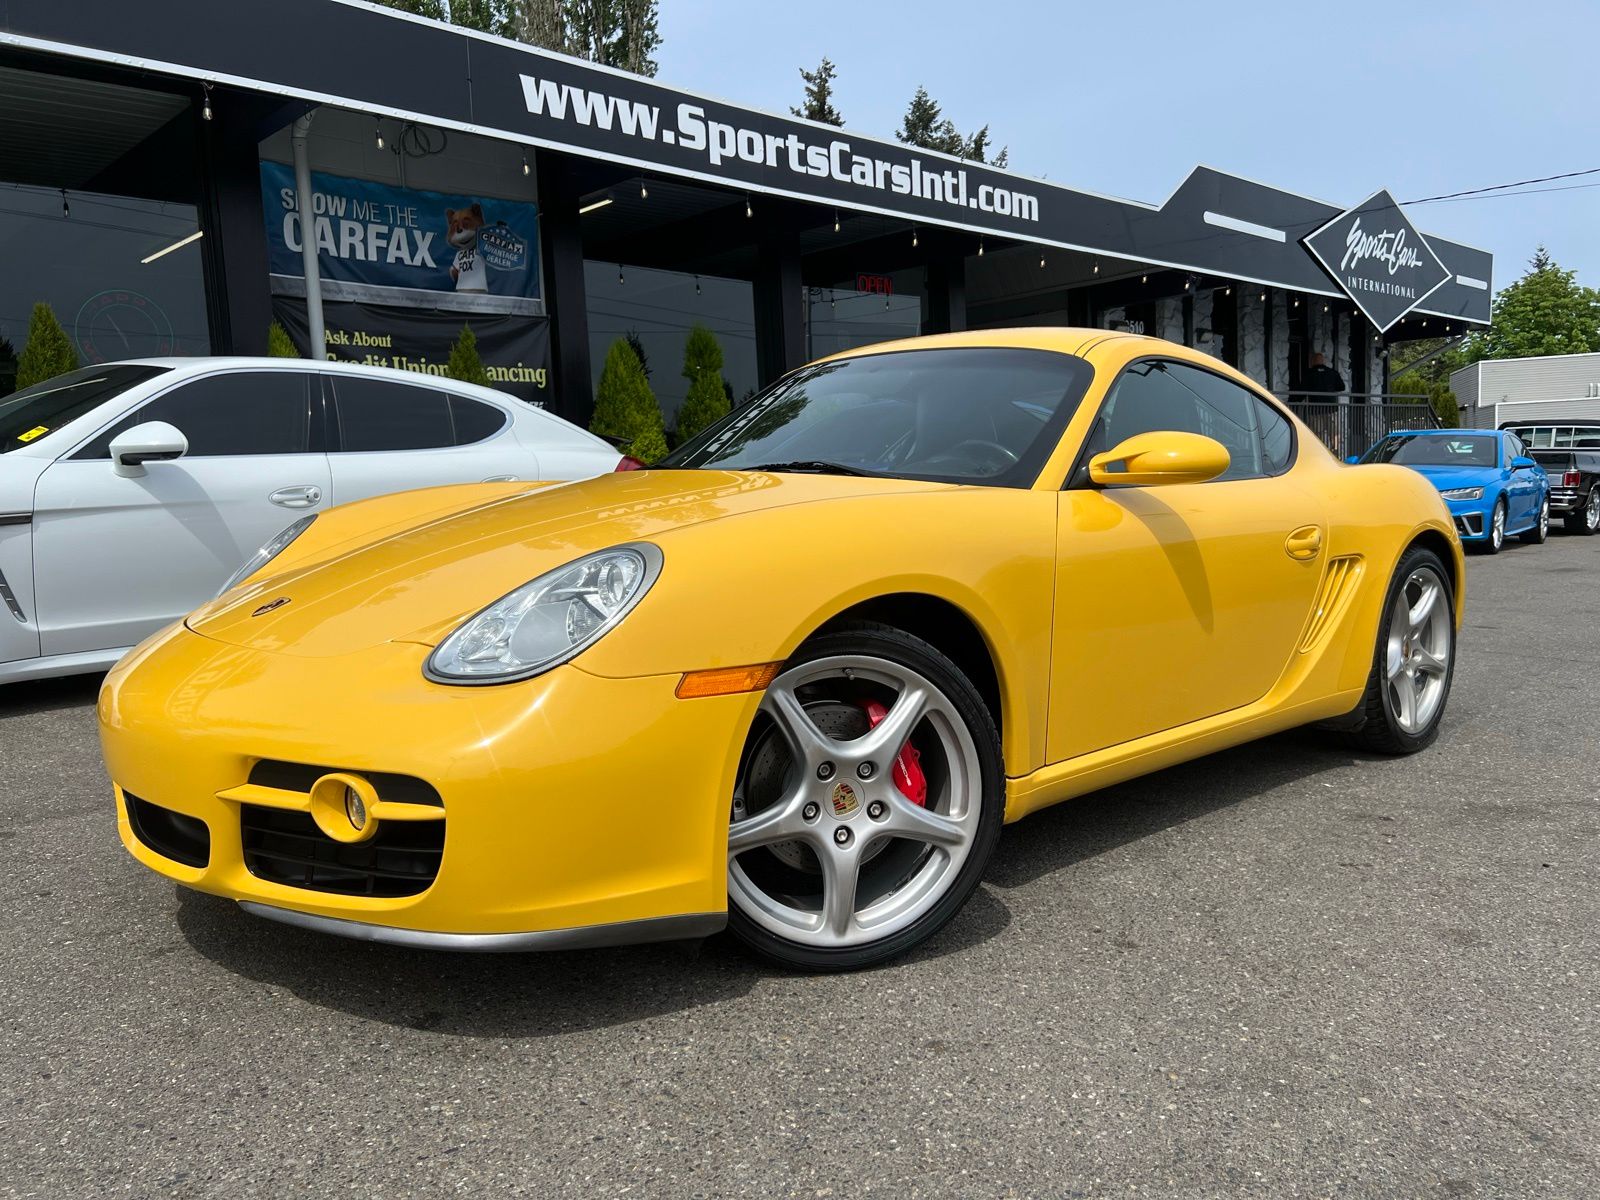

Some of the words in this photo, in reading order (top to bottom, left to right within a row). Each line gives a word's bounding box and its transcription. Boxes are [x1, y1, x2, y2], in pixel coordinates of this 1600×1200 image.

[518, 73, 1039, 221] www.SportsCarsIntl.com
[353, 199, 382, 223] ME
[384, 204, 419, 228] THE
[282, 211, 437, 269] CARFAX
[481, 232, 523, 254] CARFAX
[1340, 217, 1395, 271] Sports
[1388, 228, 1423, 275] Cars
[457, 248, 475, 261] CAR
[483, 243, 520, 262] ADVANTAGE
[486, 253, 511, 267] DEALER
[458, 260, 473, 272] FOX
[858, 275, 893, 296] OPEN
[1348, 276, 1416, 299] INTERNATIONAL
[324, 329, 350, 346] Ask
[352, 331, 392, 348] About
[326, 353, 387, 368] dit
[486, 362, 547, 388] ancing
